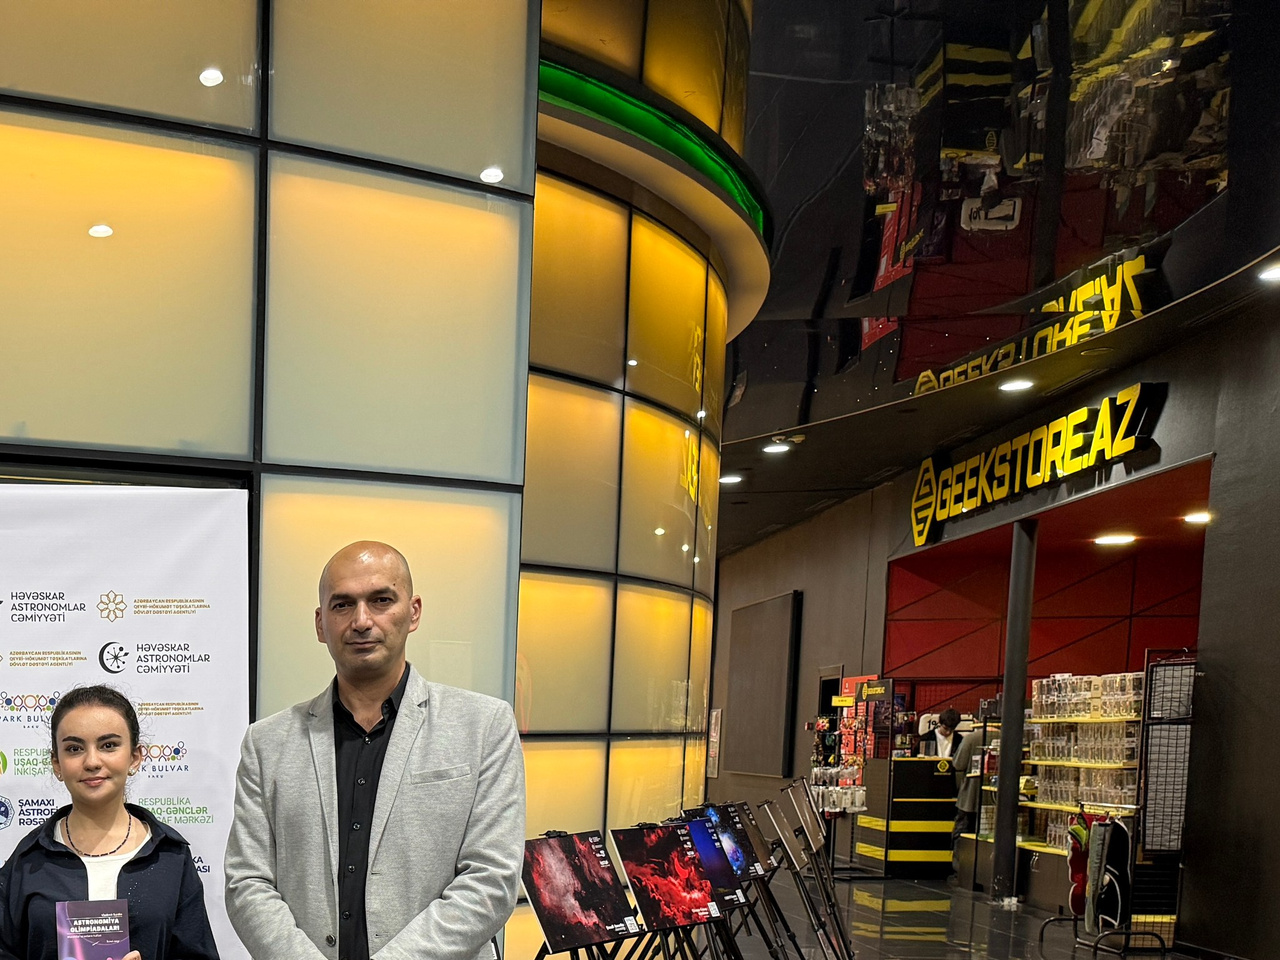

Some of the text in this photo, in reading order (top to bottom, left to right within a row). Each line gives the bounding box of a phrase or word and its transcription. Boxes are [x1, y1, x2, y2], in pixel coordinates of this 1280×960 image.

[935, 382, 1141, 519] GEEKSTORE.AZ
[10, 592, 65, 600] HƏVƏSKAR
[10, 602, 86, 611] ASTRONOMLAR
[10, 612, 66, 622] CƏMİYYƏTİ
[136, 643, 190, 652] HƏVƏSKAR
[136, 654, 210, 663] ASTRONOMLAR
[136, 663, 190, 674] CƏMİYYƏTİ
[14, 749, 51, 757] RESPUB
[18, 798, 54, 809] ŞAMAXI
[138, 796, 191, 806] RESPUBLİKA
[153, 806, 208, 816] AQ-GƏNCLƏR
[175, 814, 214, 824] MƏRKƏZİ
